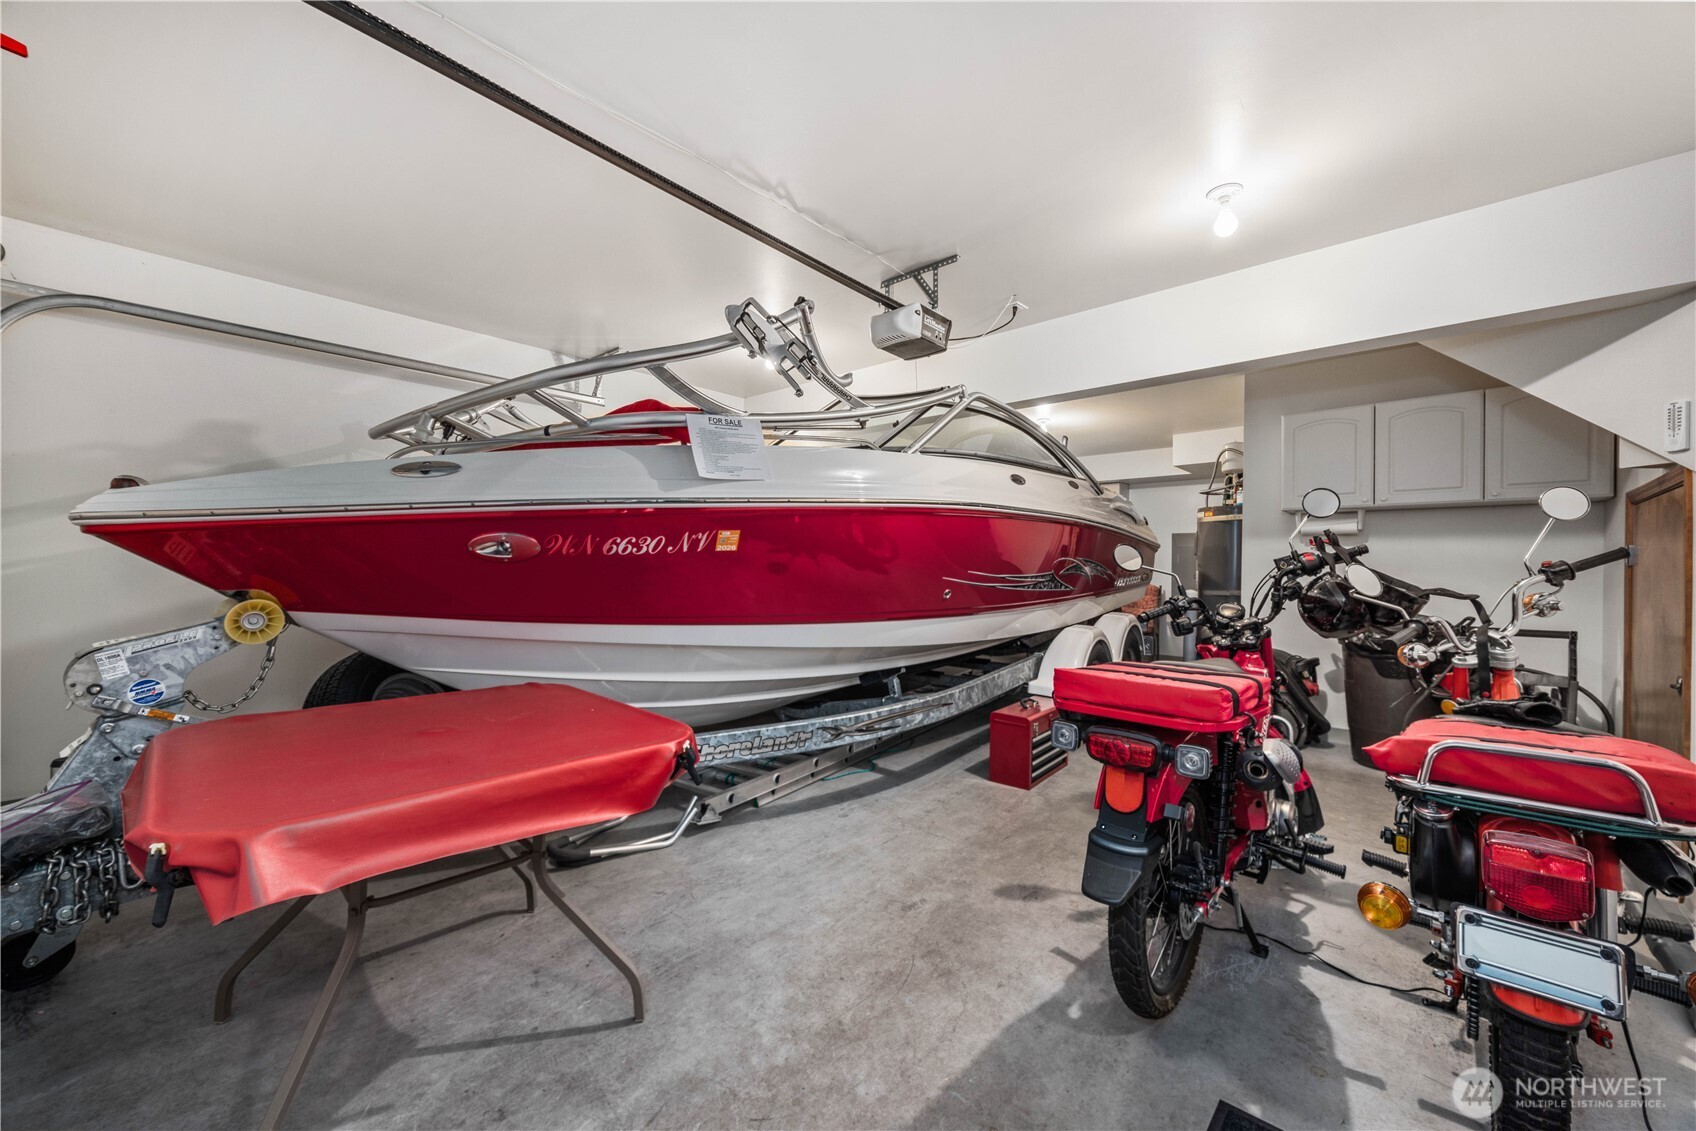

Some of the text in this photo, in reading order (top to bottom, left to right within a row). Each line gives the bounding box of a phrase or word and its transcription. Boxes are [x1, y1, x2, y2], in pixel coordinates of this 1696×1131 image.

[708, 416, 742, 426] FOR SALE
[602, 535, 666, 556] 6630
[667, 529, 717, 554] NV
